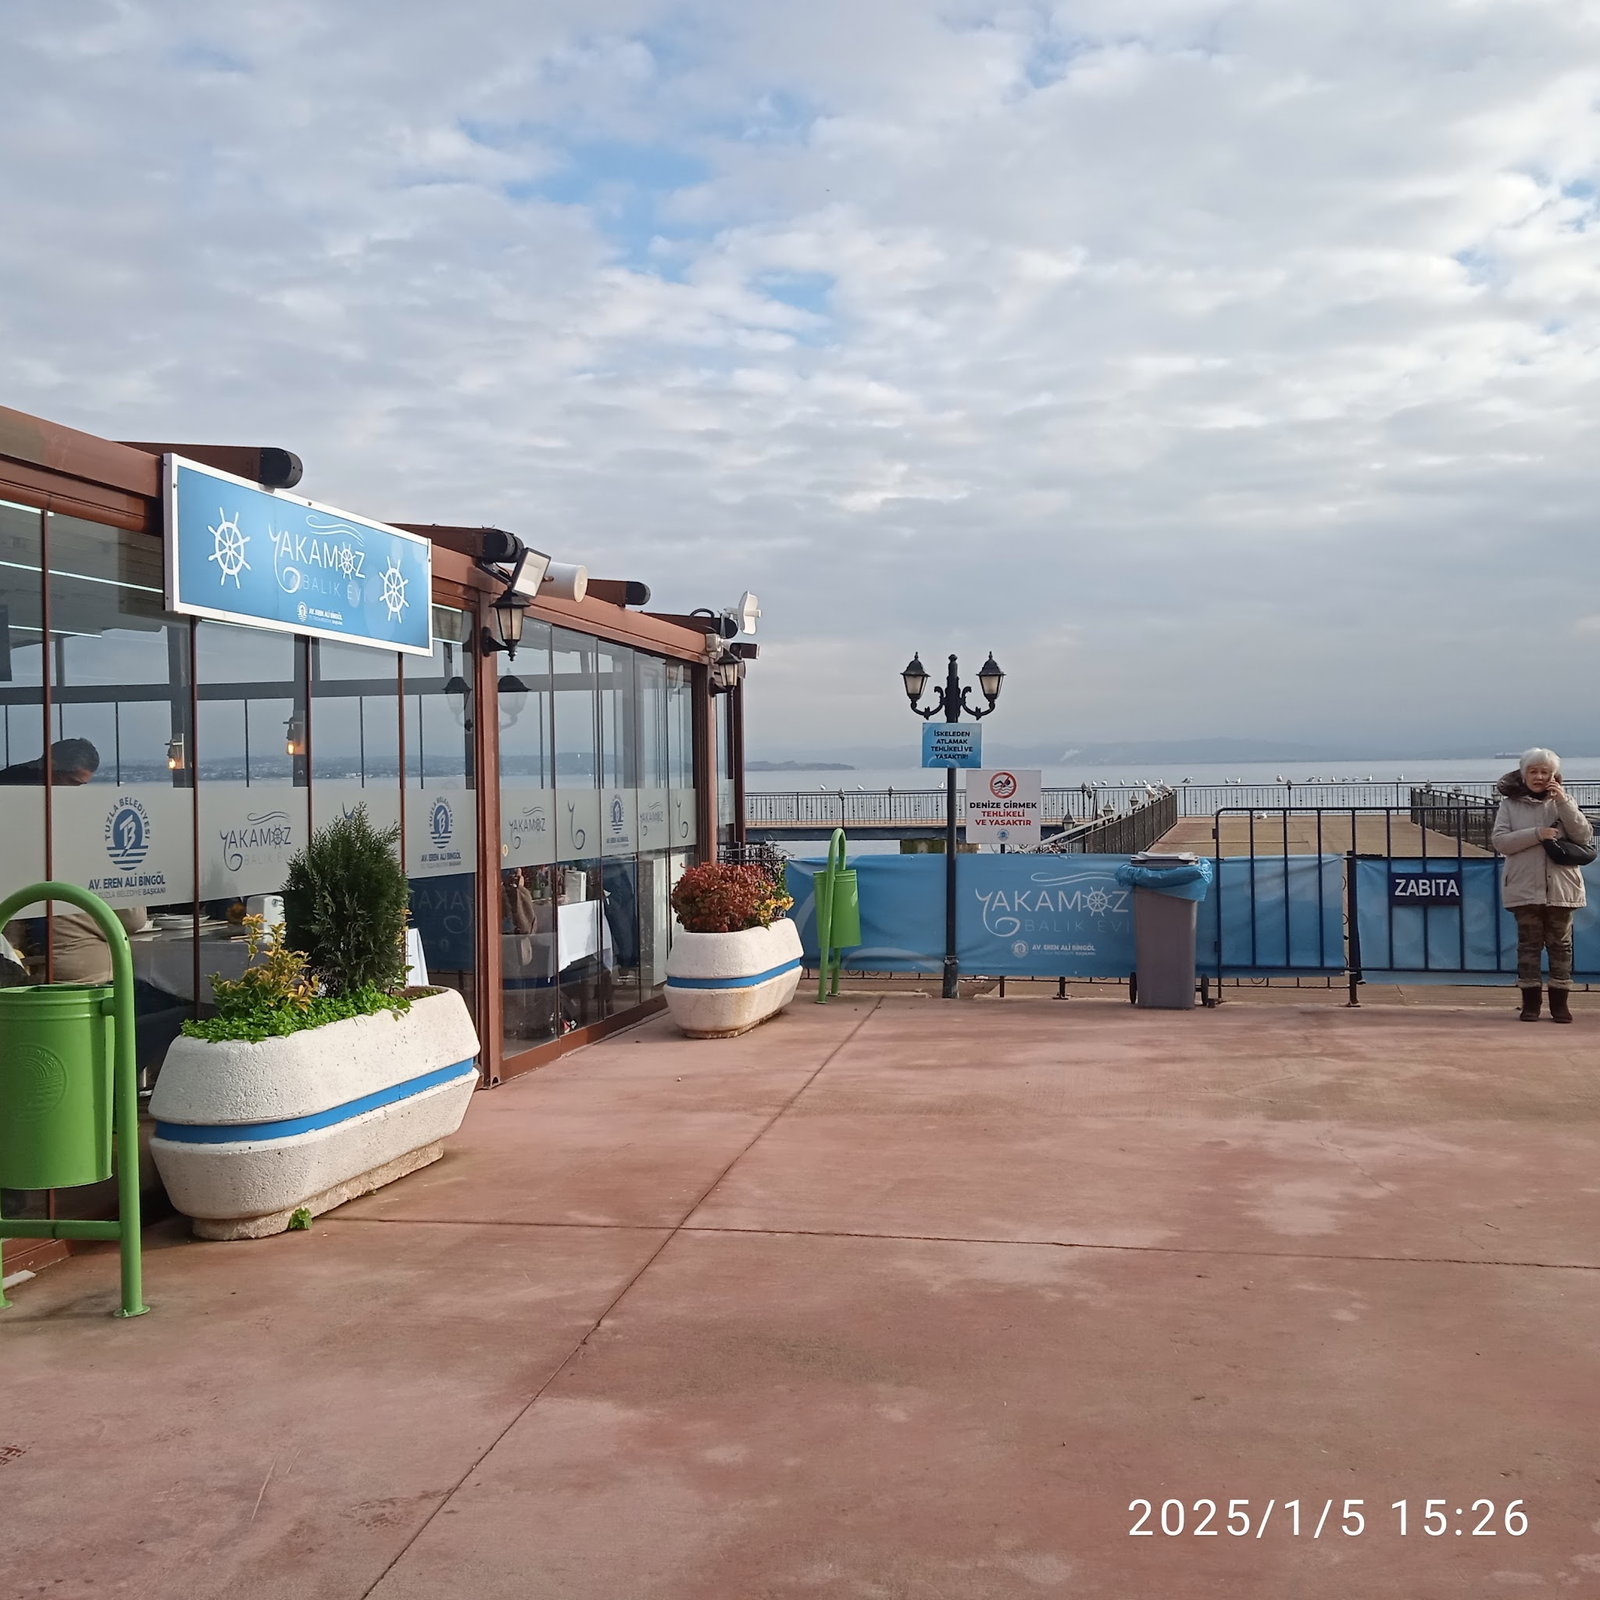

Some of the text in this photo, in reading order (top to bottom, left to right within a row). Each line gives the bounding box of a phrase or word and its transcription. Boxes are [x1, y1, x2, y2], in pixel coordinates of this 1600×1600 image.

[267, 521, 366, 594] YAKAMOZ
[303, 573, 341, 599] BALIK
[969, 800, 1037, 809] DENİZE GİRMEK
[981, 808, 1025, 818] TEHLİKELİ
[104, 804, 119, 841] TUZLA
[219, 826, 292, 872] YAKAMOZ
[88, 871, 166, 891] AV. EREN ALİ BİNGÖL
[1394, 878, 1460, 897] ZABITA
[975, 885, 1129, 937] YAKAMOZ
[1024, 919, 1084, 932] BALIK
